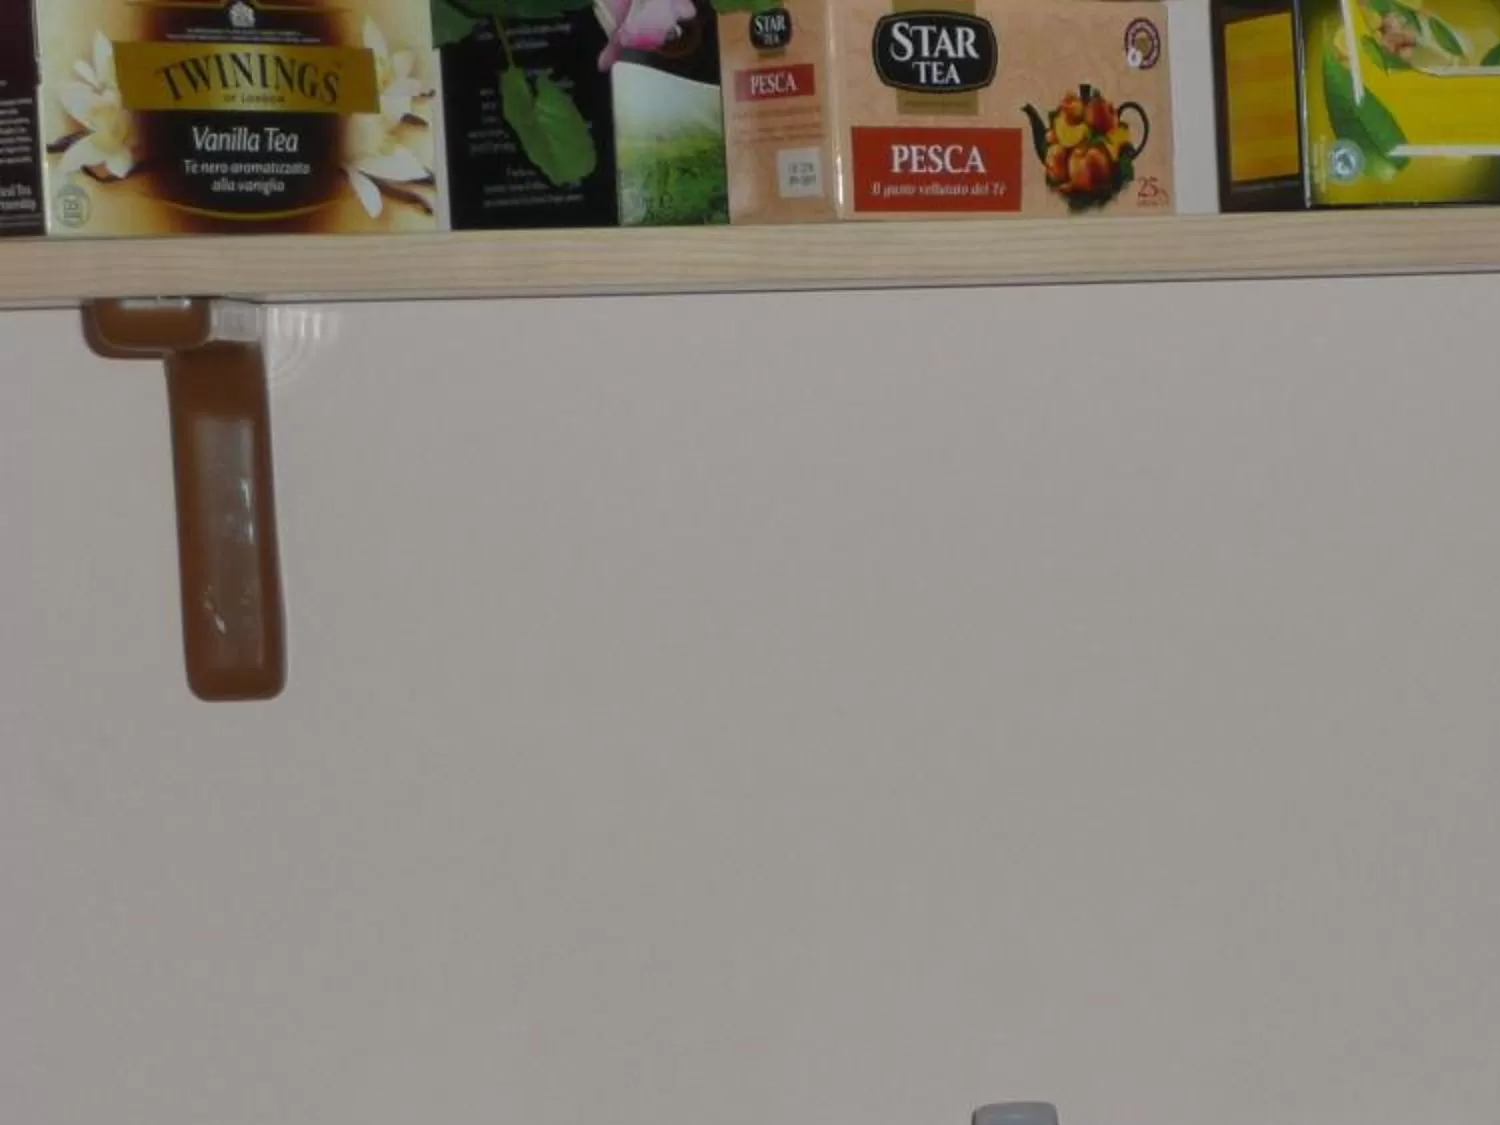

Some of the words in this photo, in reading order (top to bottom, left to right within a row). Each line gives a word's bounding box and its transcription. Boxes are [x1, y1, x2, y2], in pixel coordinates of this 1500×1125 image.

[754, 15, 787, 35] STAR
[890, 21, 980, 61] STAR
[155, 51, 339, 105] TWININGS
[751, 72, 798, 96] PESCA
[912, 61, 961, 84] TEA
[192, 126, 260, 152] Vanilla
[264, 127, 299, 153] Tea
[891, 145, 986, 174] PESCA
